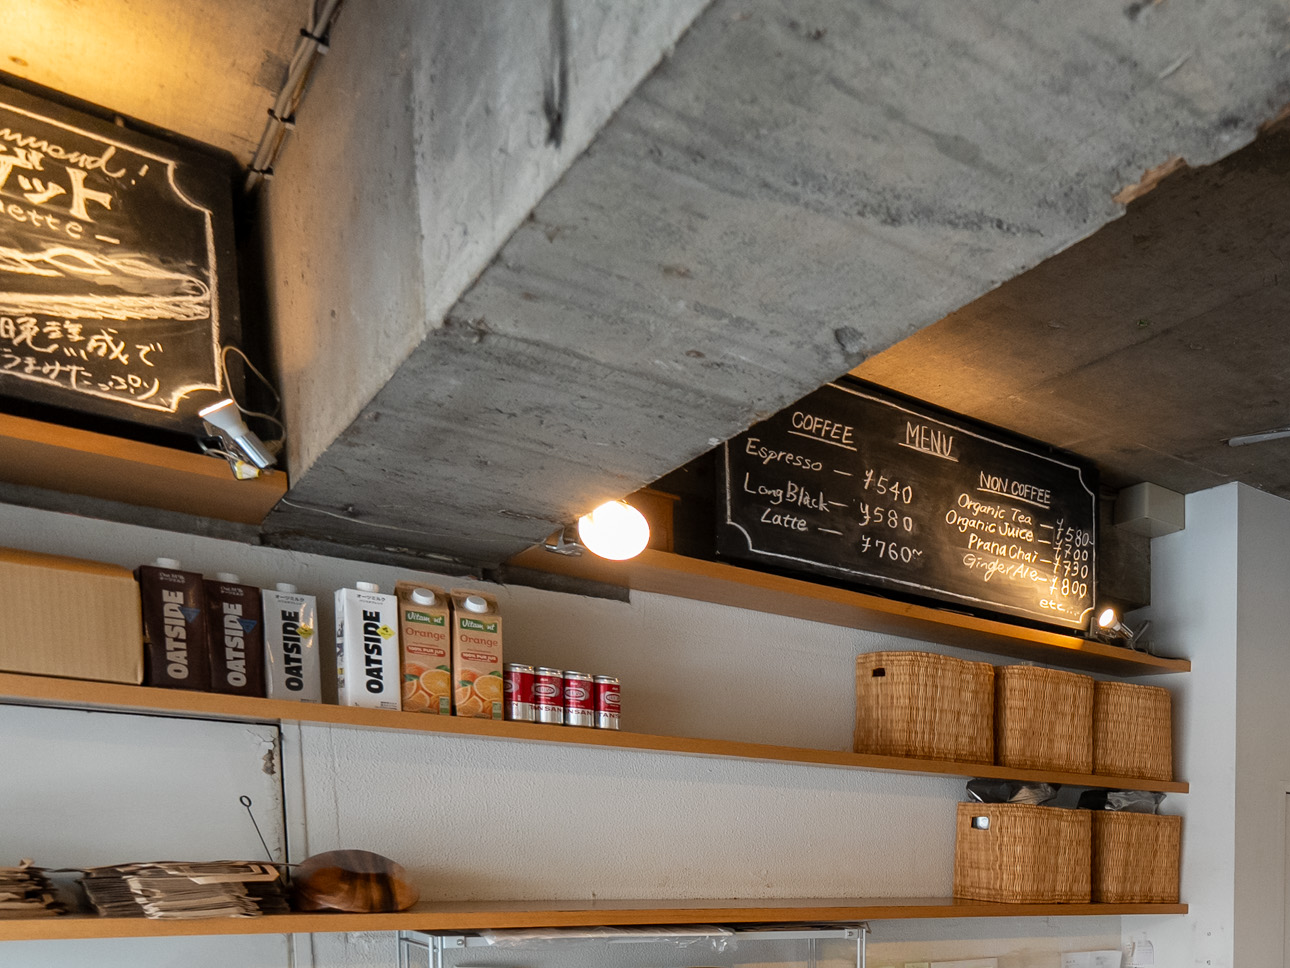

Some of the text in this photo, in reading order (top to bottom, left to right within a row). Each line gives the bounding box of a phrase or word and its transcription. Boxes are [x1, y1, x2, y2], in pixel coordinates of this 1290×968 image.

[0, 201, 83, 239] ette
[791, 411, 854, 444] COFFEE
[905, 421, 954, 457] MENU
[745, 438, 822, 471] Espresso
[979, 471, 1051, 504] NON COFFEE
[760, 508, 808, 531] Latte
[957, 493, 1006, 519] Organic
[1011, 508, 1032, 525] Tea
[945, 510, 996, 533] Organic
[999, 522, 1035, 542] Juice
[967, 533, 1007, 557] Prana
[1008, 544, 1039, 563] Chai
[962, 553, 1014, 582] Ginger
[162, 589, 189, 680] OATSIDE
[222, 602, 247, 688] OATSIDE
[281, 609, 304, 692] OATSIDE
[405, 627, 446, 641] Orange
[460, 634, 499, 648] Orange
[362, 609, 384, 694] OATSIDE
